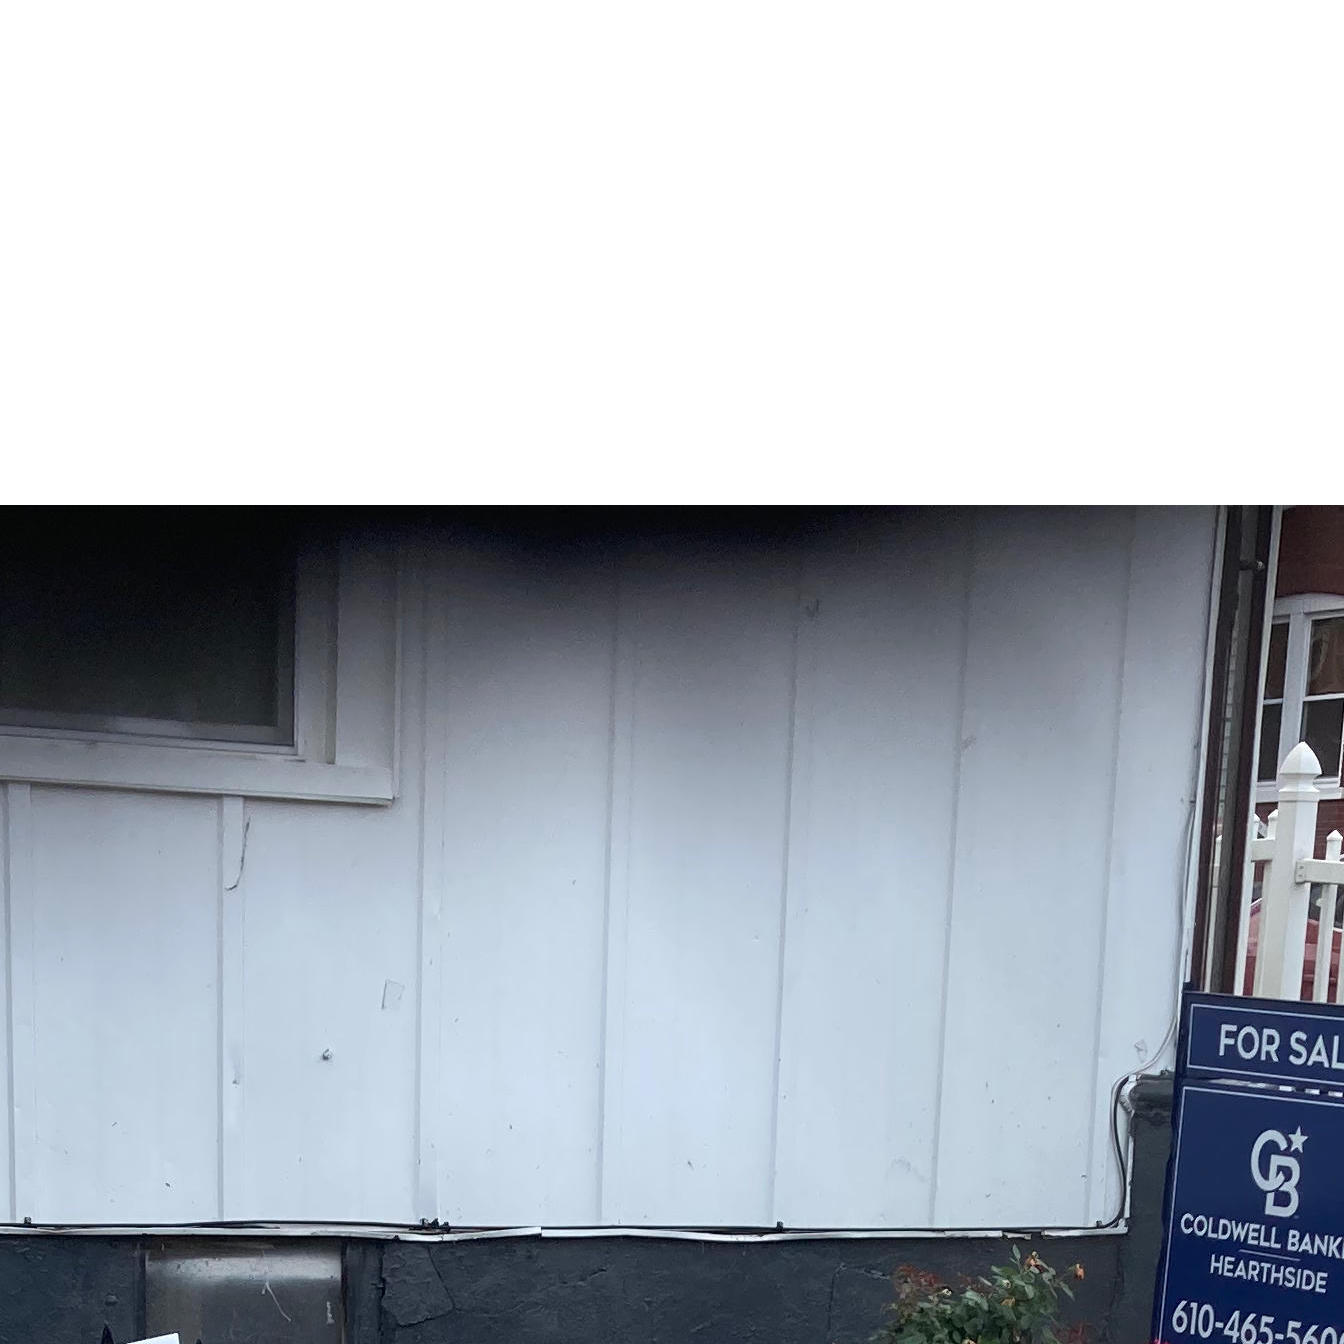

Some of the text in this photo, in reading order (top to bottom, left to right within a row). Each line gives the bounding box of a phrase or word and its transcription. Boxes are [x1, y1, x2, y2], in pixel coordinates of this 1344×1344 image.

[1218, 1024, 1281, 1062] FOR
[1180, 1214, 1281, 1250] COLDWELL
[1210, 1254, 1328, 1293] HEARTHSIDE
